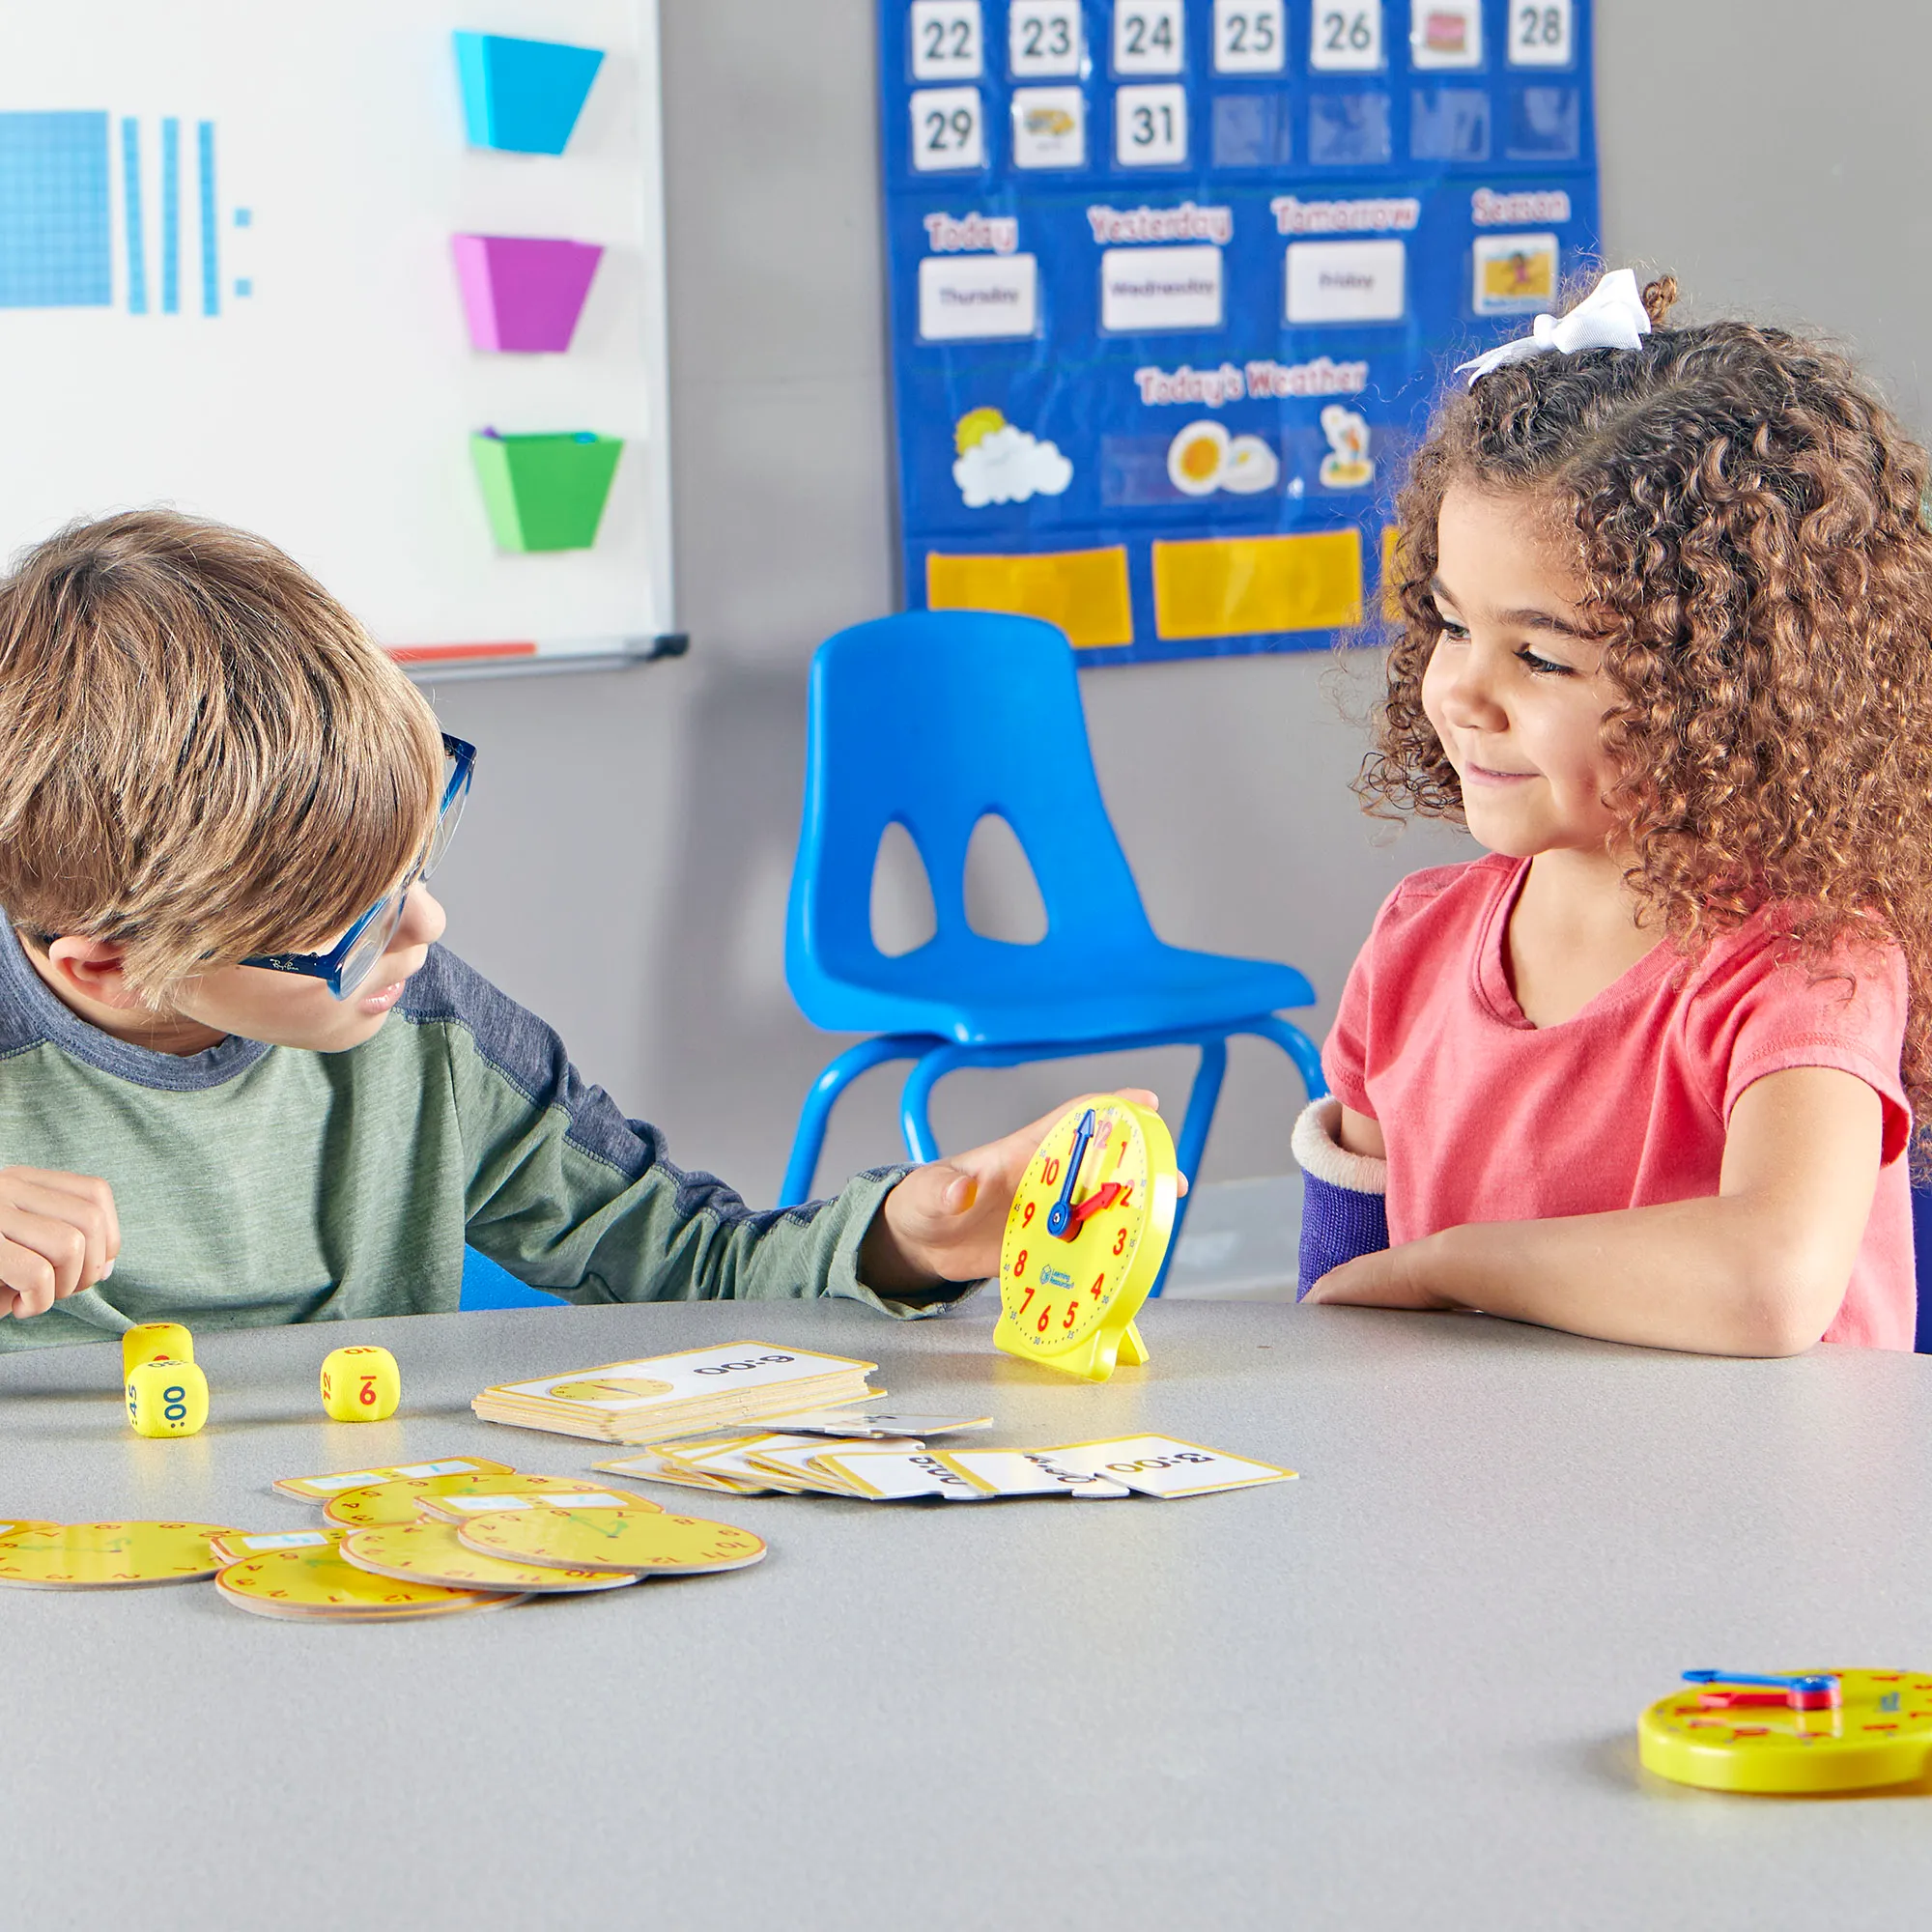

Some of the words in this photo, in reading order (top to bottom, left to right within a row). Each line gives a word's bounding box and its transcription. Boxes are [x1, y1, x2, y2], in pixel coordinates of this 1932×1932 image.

[923, 19, 972, 60] 22
[1022, 17, 1071, 57] 23
[1124, 15, 1174, 56] 24
[1226, 12, 1274, 53] 25
[1323, 11, 1371, 51] 26
[1519, 6, 1560, 47] 28
[924, 108, 974, 151] 29
[1132, 105, 1173, 146] 31
[1272, 197, 1418, 234] Tomorrow
[1473, 189, 1569, 224] Season
[925, 213, 1017, 253] Today
[1089, 203, 1232, 243] Yesterday
[1319, 270, 1374, 292] Friday
[939, 287, 1018, 307] Thursday
[1136, 365, 1243, 406] Today's
[1246, 358, 1366, 397] Weather
[1093, 1121, 1113, 1149] 12
[1117, 1141, 1127, 1168] 1
[1040, 1156, 1060, 1186] 10
[1120, 1179, 1135, 1207] 2
[1022, 1202, 1036, 1229] 9
[1113, 1227, 1127, 1256] 3
[1013, 1249, 1028, 1277] 8
[1091, 1272, 1104, 1301] 4
[1019, 1287, 1035, 1315] 7
[1063, 1301, 1079, 1328] 5
[1037, 1305, 1051, 1332] 6
[1105, 1452, 1216, 1474] 3:00
